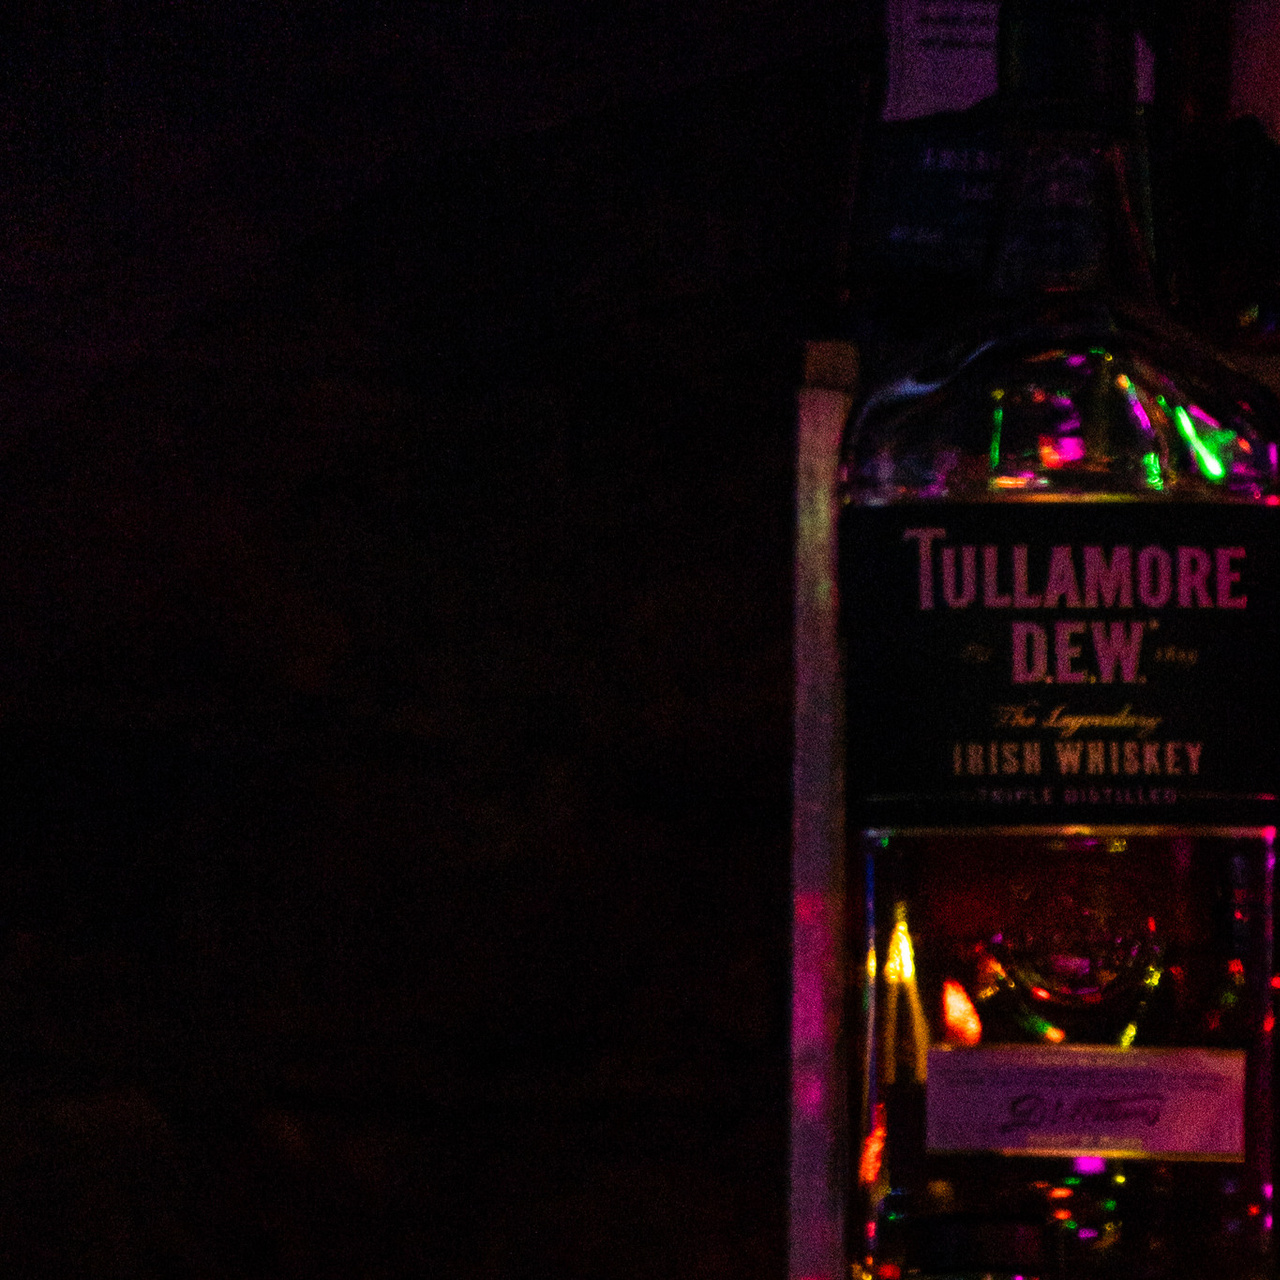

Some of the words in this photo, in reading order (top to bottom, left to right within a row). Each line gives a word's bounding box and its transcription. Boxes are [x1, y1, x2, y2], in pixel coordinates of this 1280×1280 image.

[903, 525, 1249, 611] TULLAMORE
[953, 740, 1042, 776] IRISH
[1055, 740, 1203, 777] WHISKEY
